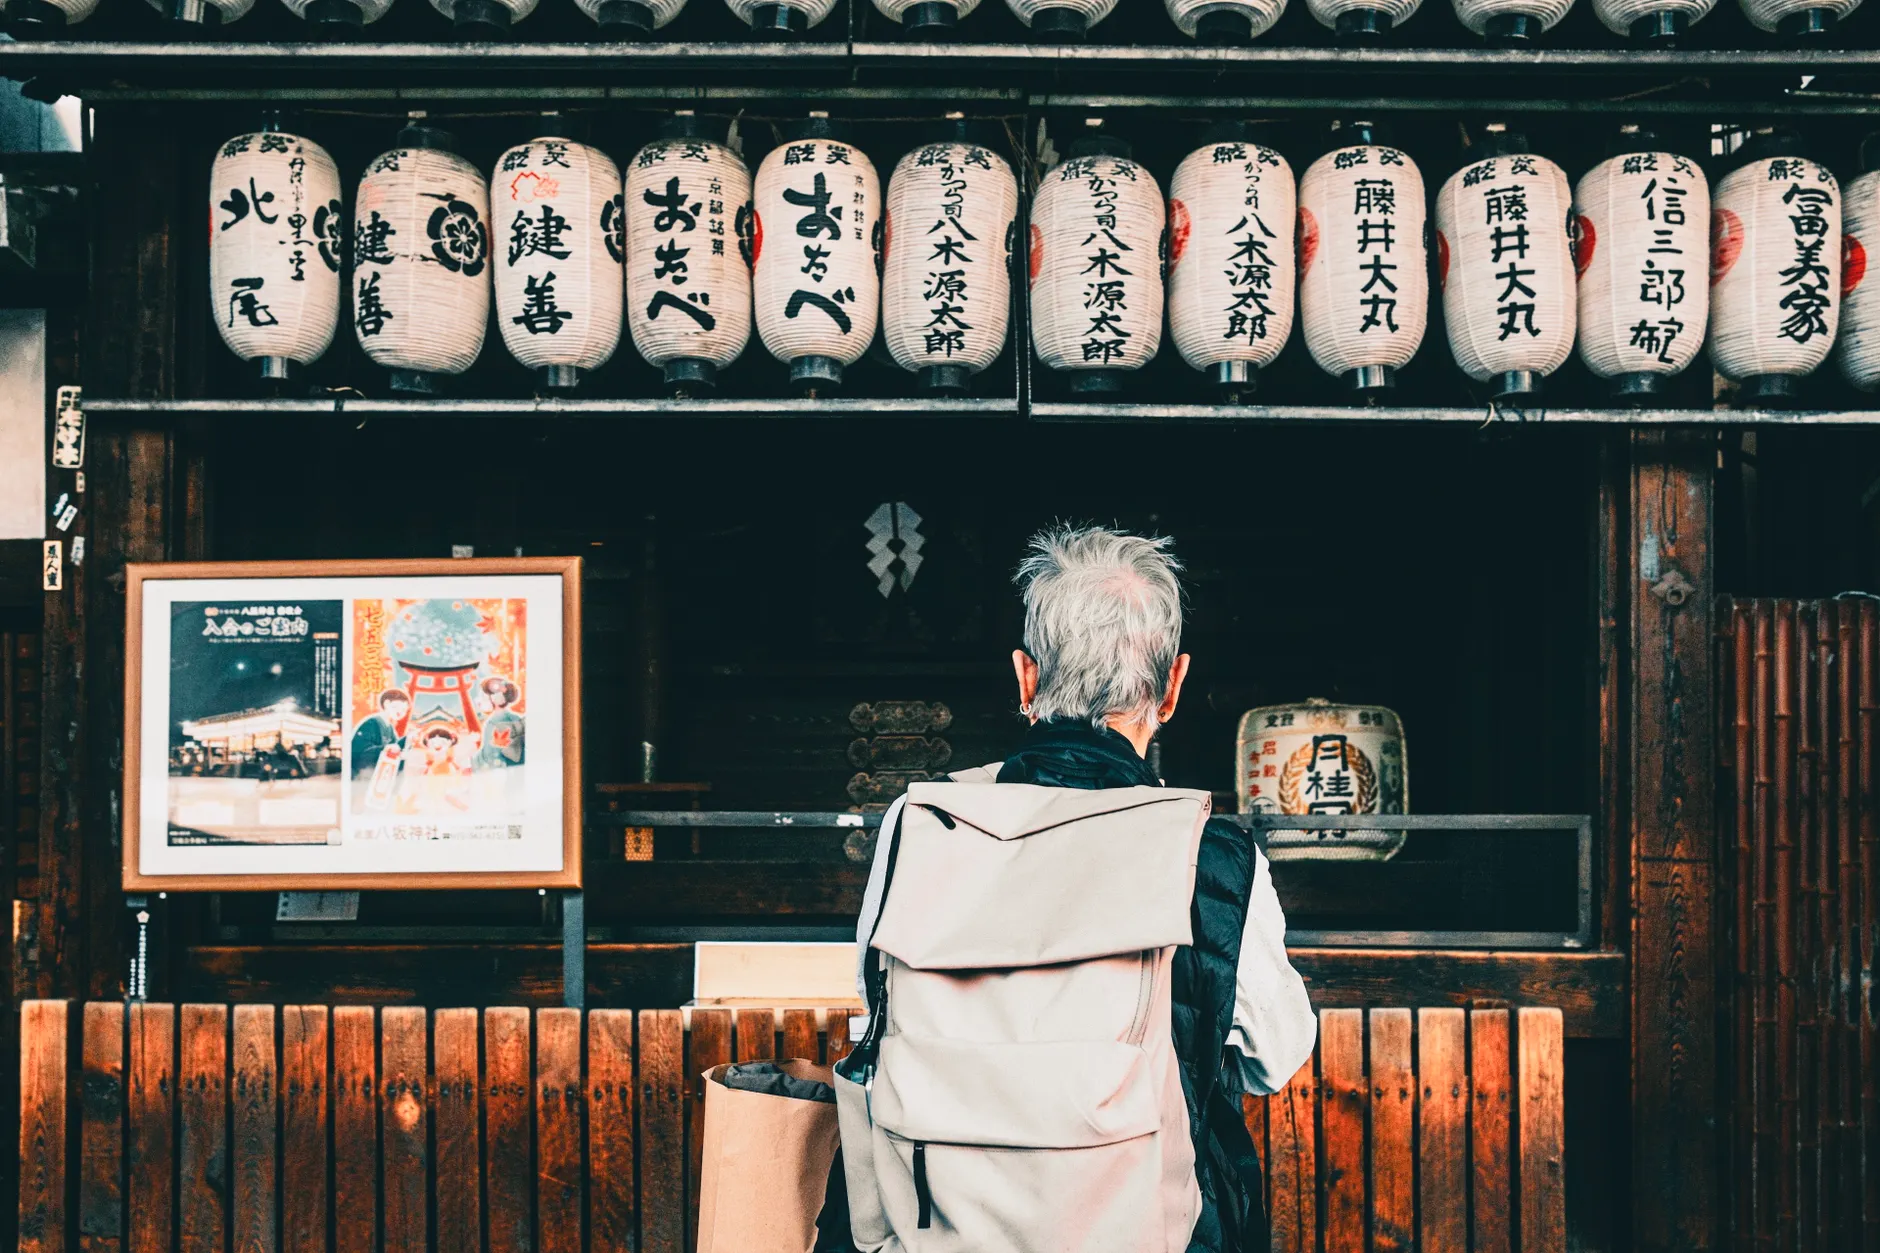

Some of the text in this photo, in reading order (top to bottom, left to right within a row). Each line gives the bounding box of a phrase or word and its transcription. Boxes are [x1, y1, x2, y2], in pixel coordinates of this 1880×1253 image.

[219, 177, 279, 328] 北尾
[507, 204, 573, 335] 鍵善
[643, 176, 717, 331] おたべ
[782, 172, 856, 335] おたべ
[1354, 178, 1400, 334] 藤井大丸
[1483, 184, 1542, 342] 藤井大丸
